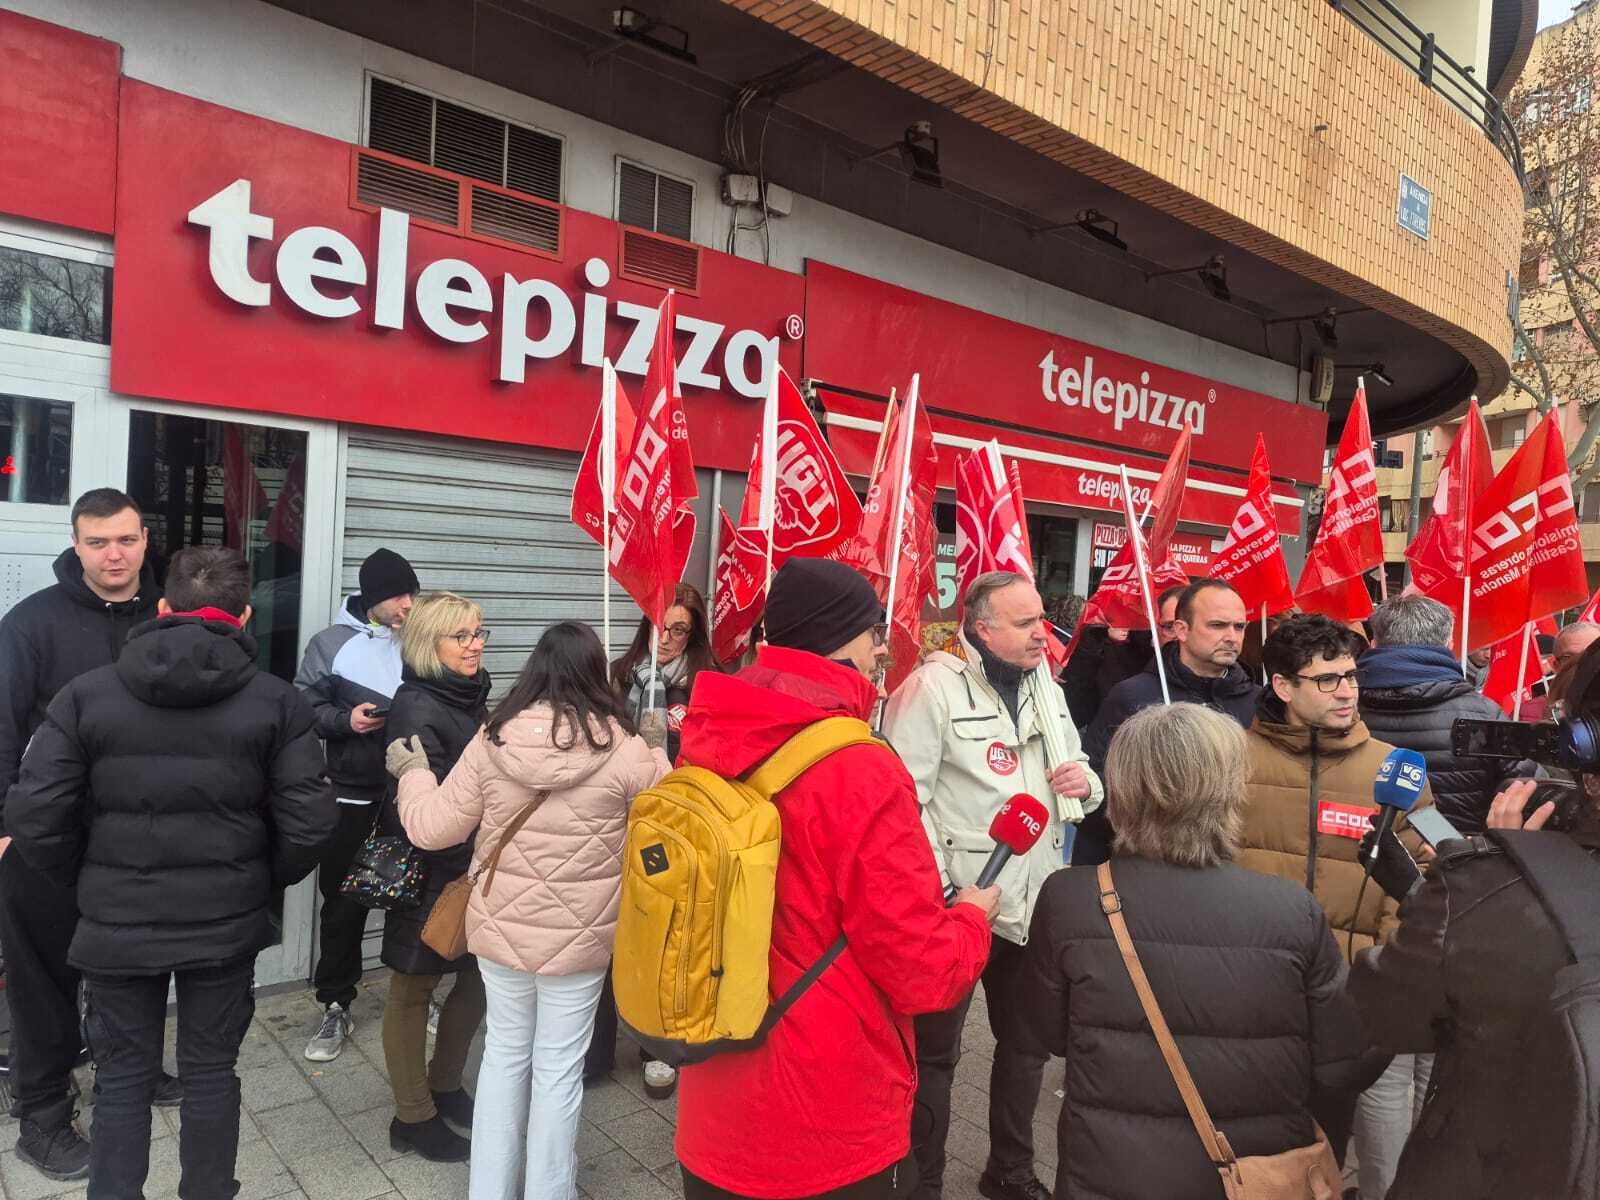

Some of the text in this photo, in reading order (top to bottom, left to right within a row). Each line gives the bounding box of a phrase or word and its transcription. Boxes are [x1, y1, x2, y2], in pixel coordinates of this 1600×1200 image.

[187, 178, 780, 398] telepizza
[1038, 350, 1206, 435] telepizza
[937, 543, 956, 556] ME
[1231, 529, 1276, 561] obreras
[670, 705, 687, 721] UG
[991, 746, 1013, 763] UGT
[1018, 810, 1041, 836] rne
